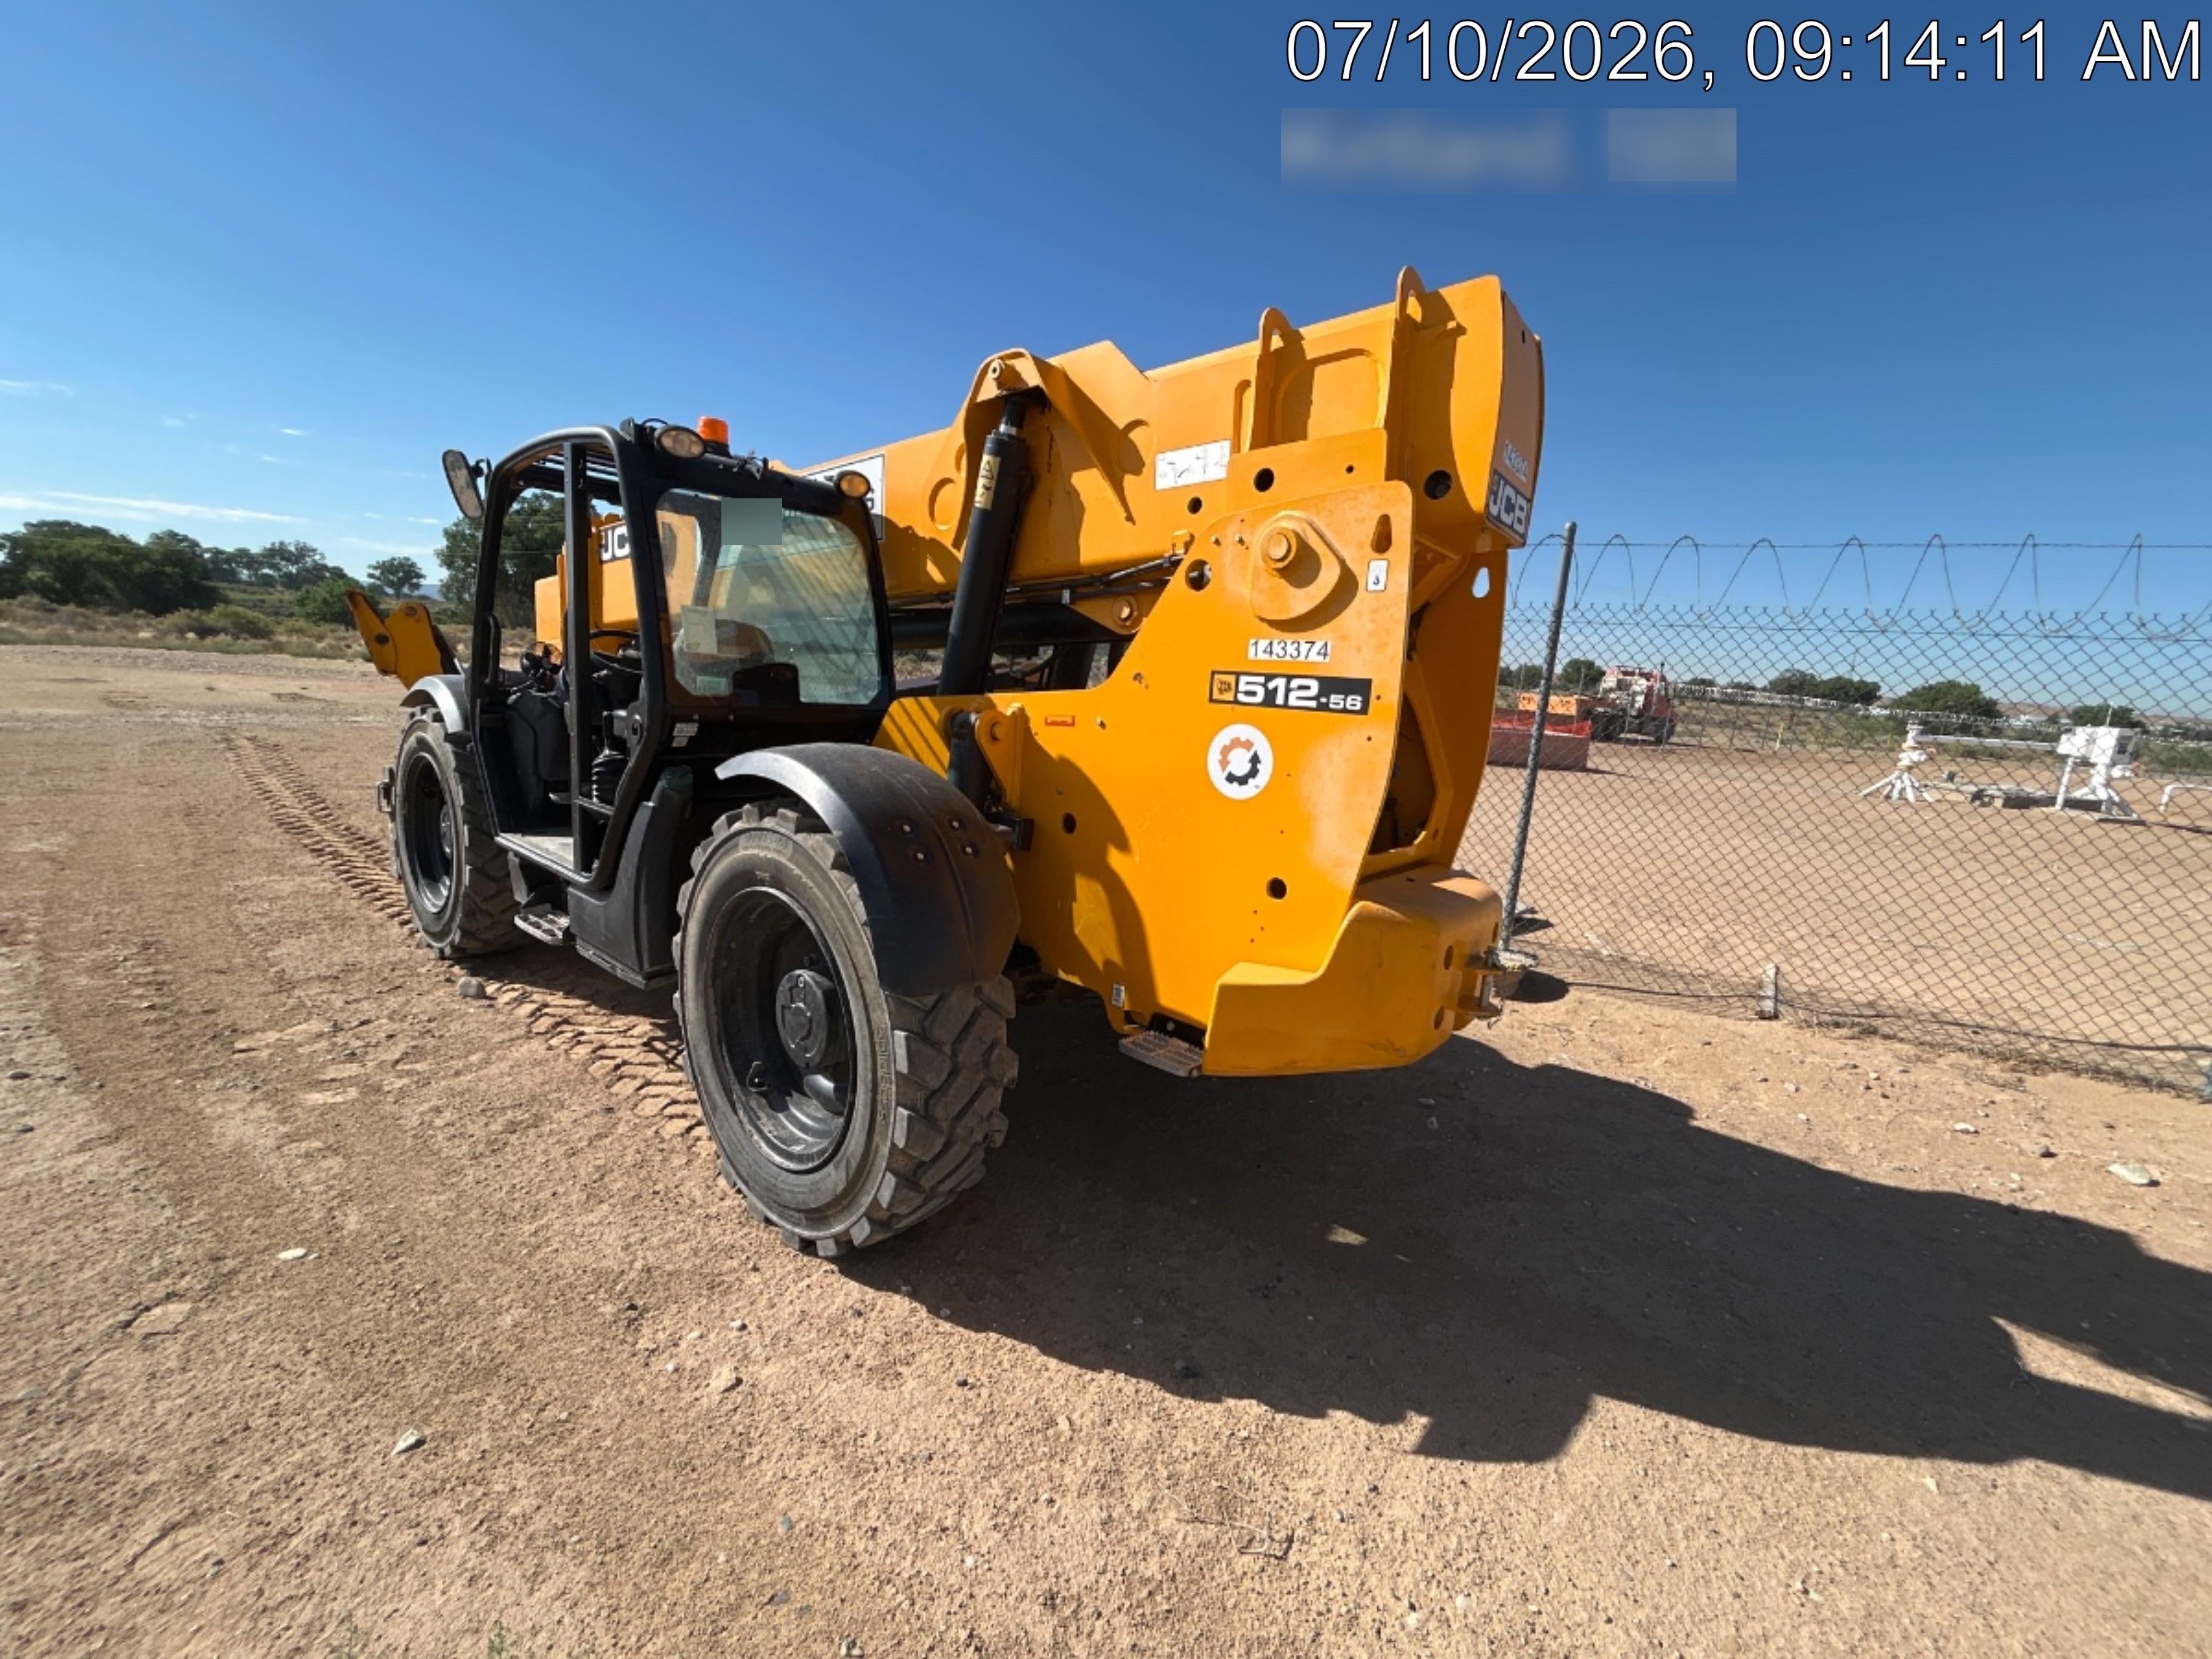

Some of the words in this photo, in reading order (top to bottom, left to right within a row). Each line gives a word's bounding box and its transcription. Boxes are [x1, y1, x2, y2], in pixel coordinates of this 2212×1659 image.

[1489, 478, 1528, 534] JCB
[601, 525, 630, 561] JC
[1251, 640, 1329, 661] 143374
